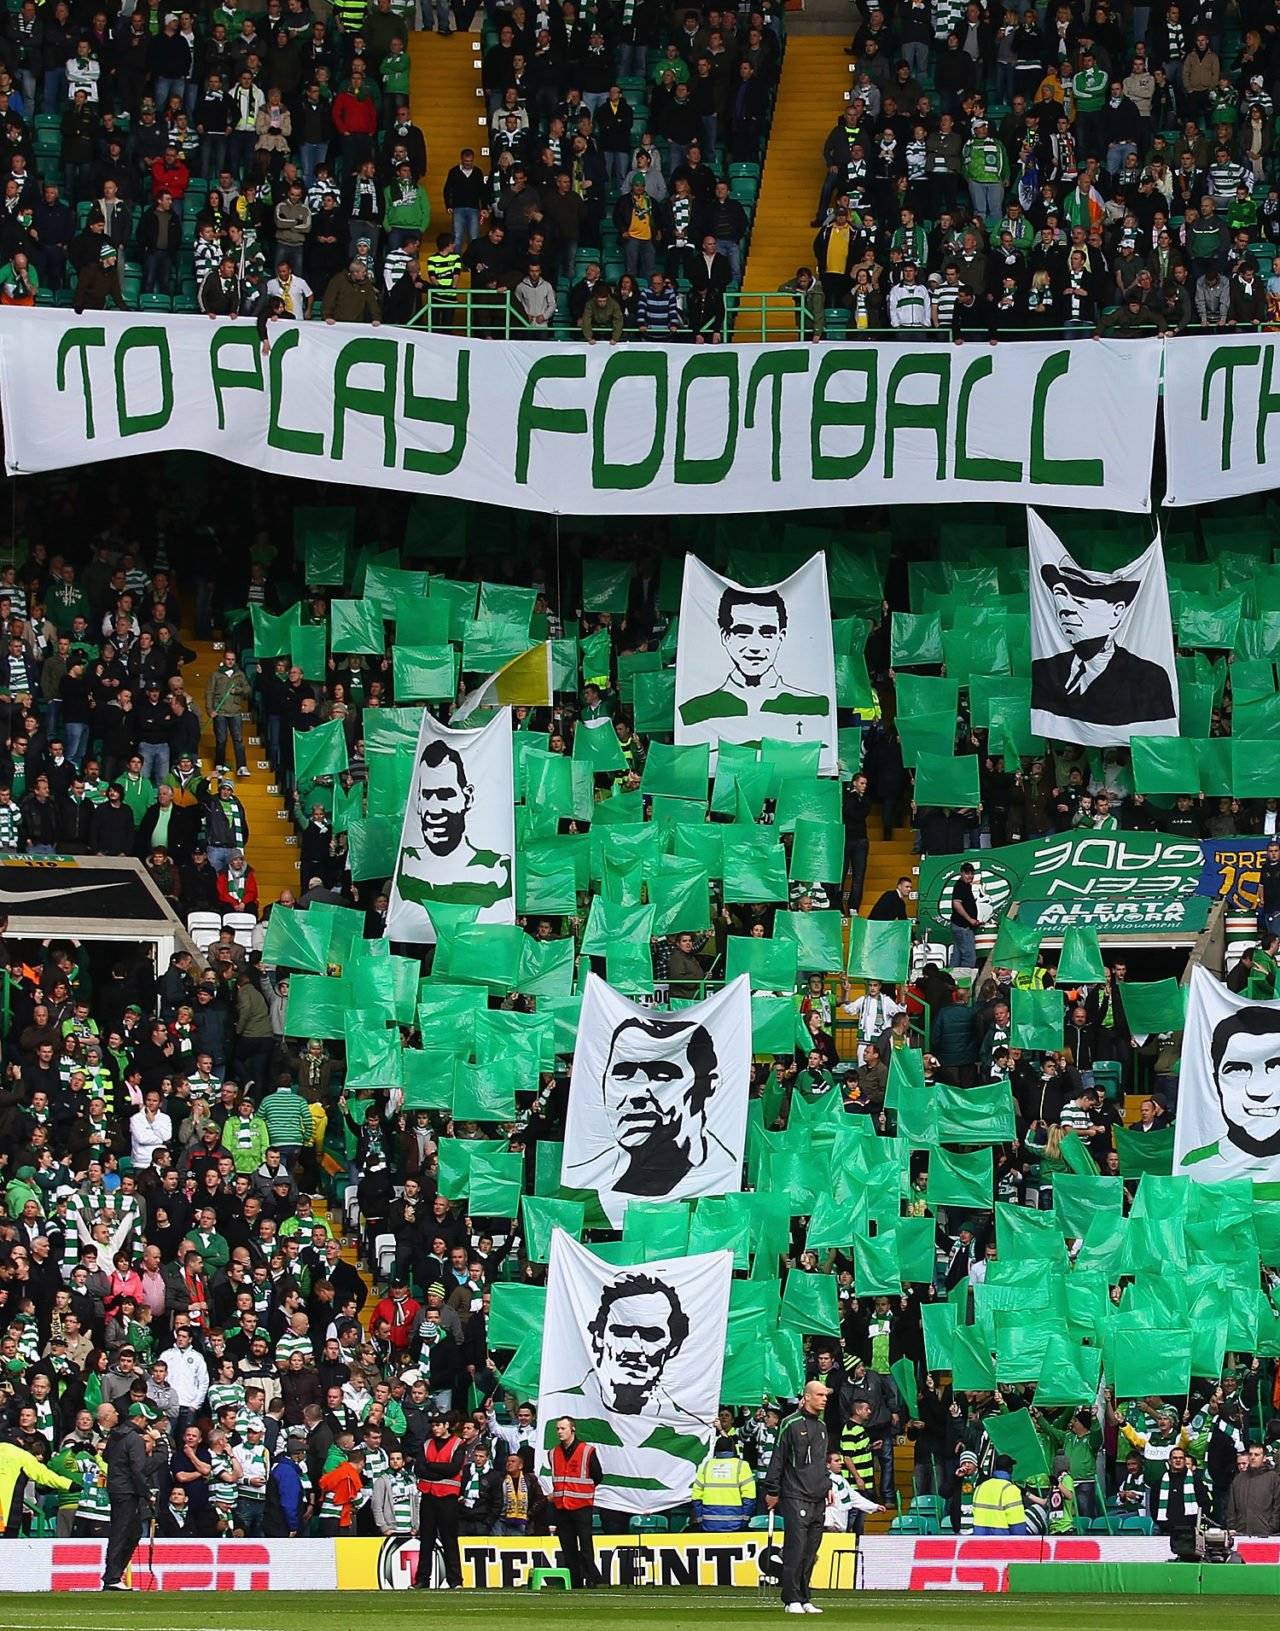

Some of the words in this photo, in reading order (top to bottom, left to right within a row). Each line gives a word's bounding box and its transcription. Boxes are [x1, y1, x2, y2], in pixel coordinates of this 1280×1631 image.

[56, 326, 174, 440] TO
[210, 326, 470, 475] PLAY
[514, 349, 1104, 490] FOOTBALL
[1041, 902, 1186, 915] ALERTA
[1036, 912, 1185, 925] NETWORK
[1033, 922, 1110, 932] antifist
[1112, 921, 1182, 930] movement
